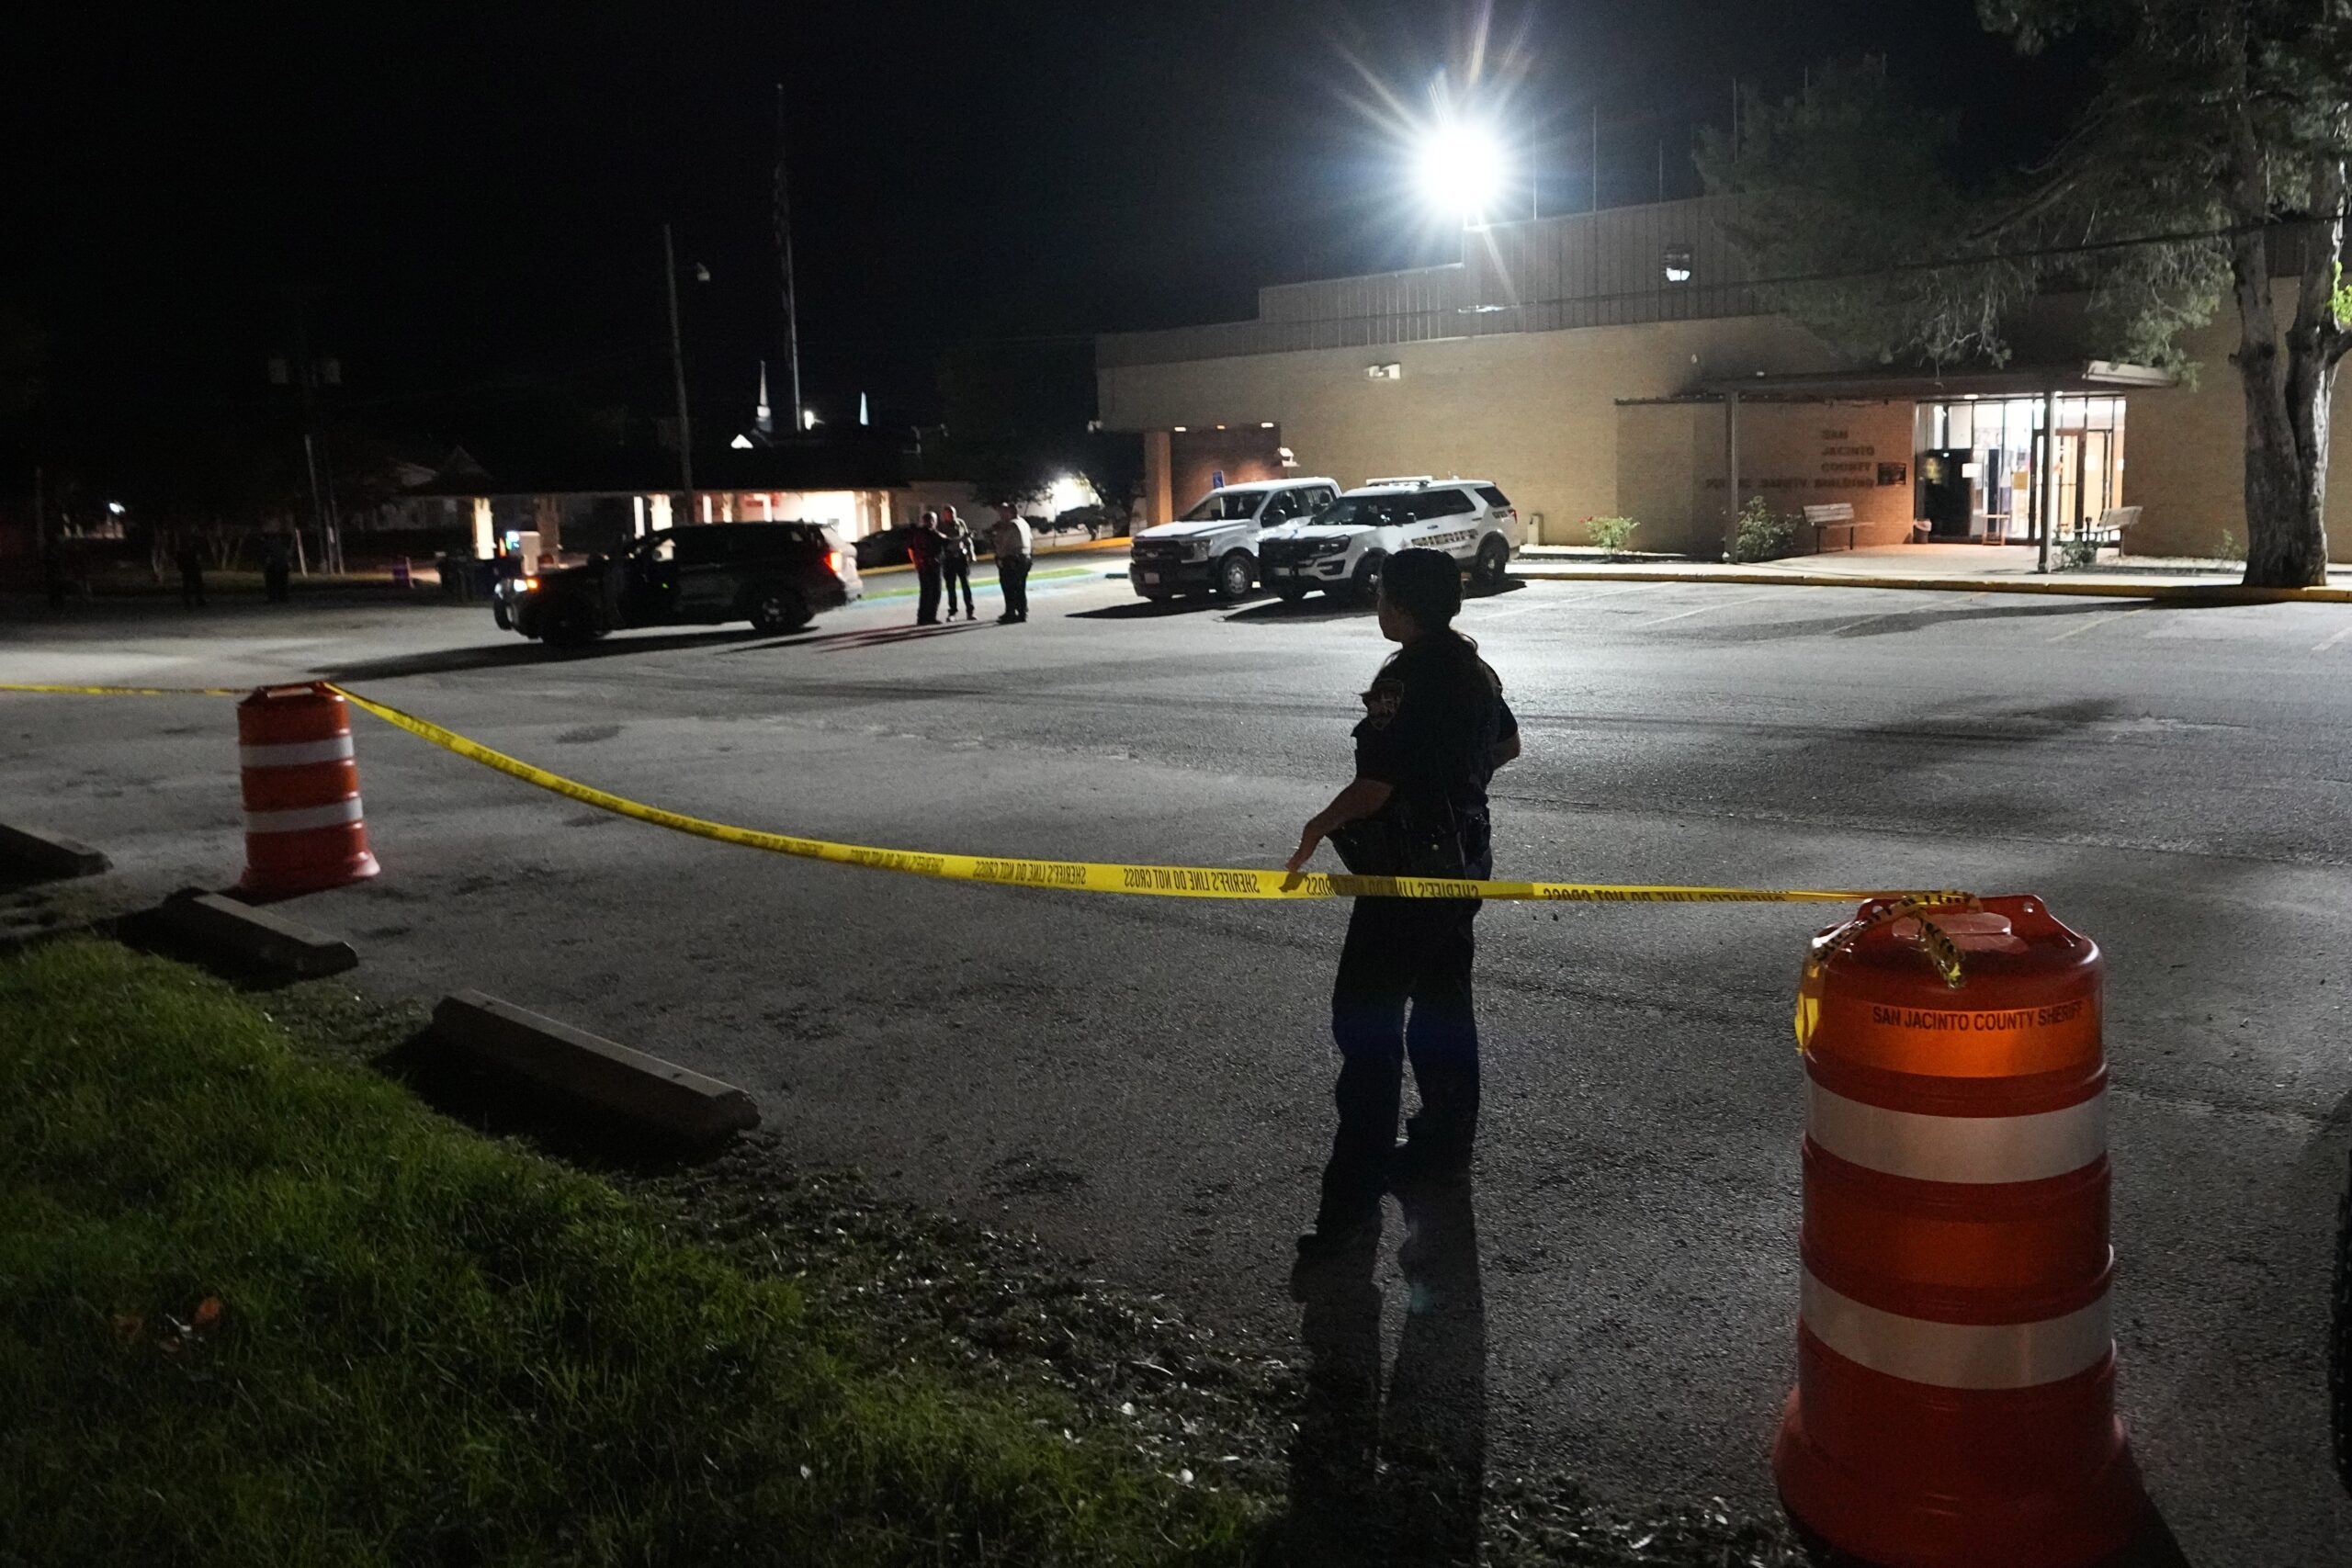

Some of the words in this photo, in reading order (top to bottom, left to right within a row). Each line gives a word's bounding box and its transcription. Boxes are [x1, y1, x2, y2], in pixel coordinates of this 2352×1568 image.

[1822, 430, 1849, 440] SAN
[1822, 446, 1875, 457] JACINTO
[1821, 461, 1872, 472] COUNTY
[1872, 1006, 1901, 1026] SAN
[1905, 1012, 1970, 1031] JACINTO
[1973, 1010, 2035, 1031] COUNTY
[2037, 1000, 2083, 1026] SHERIFF
